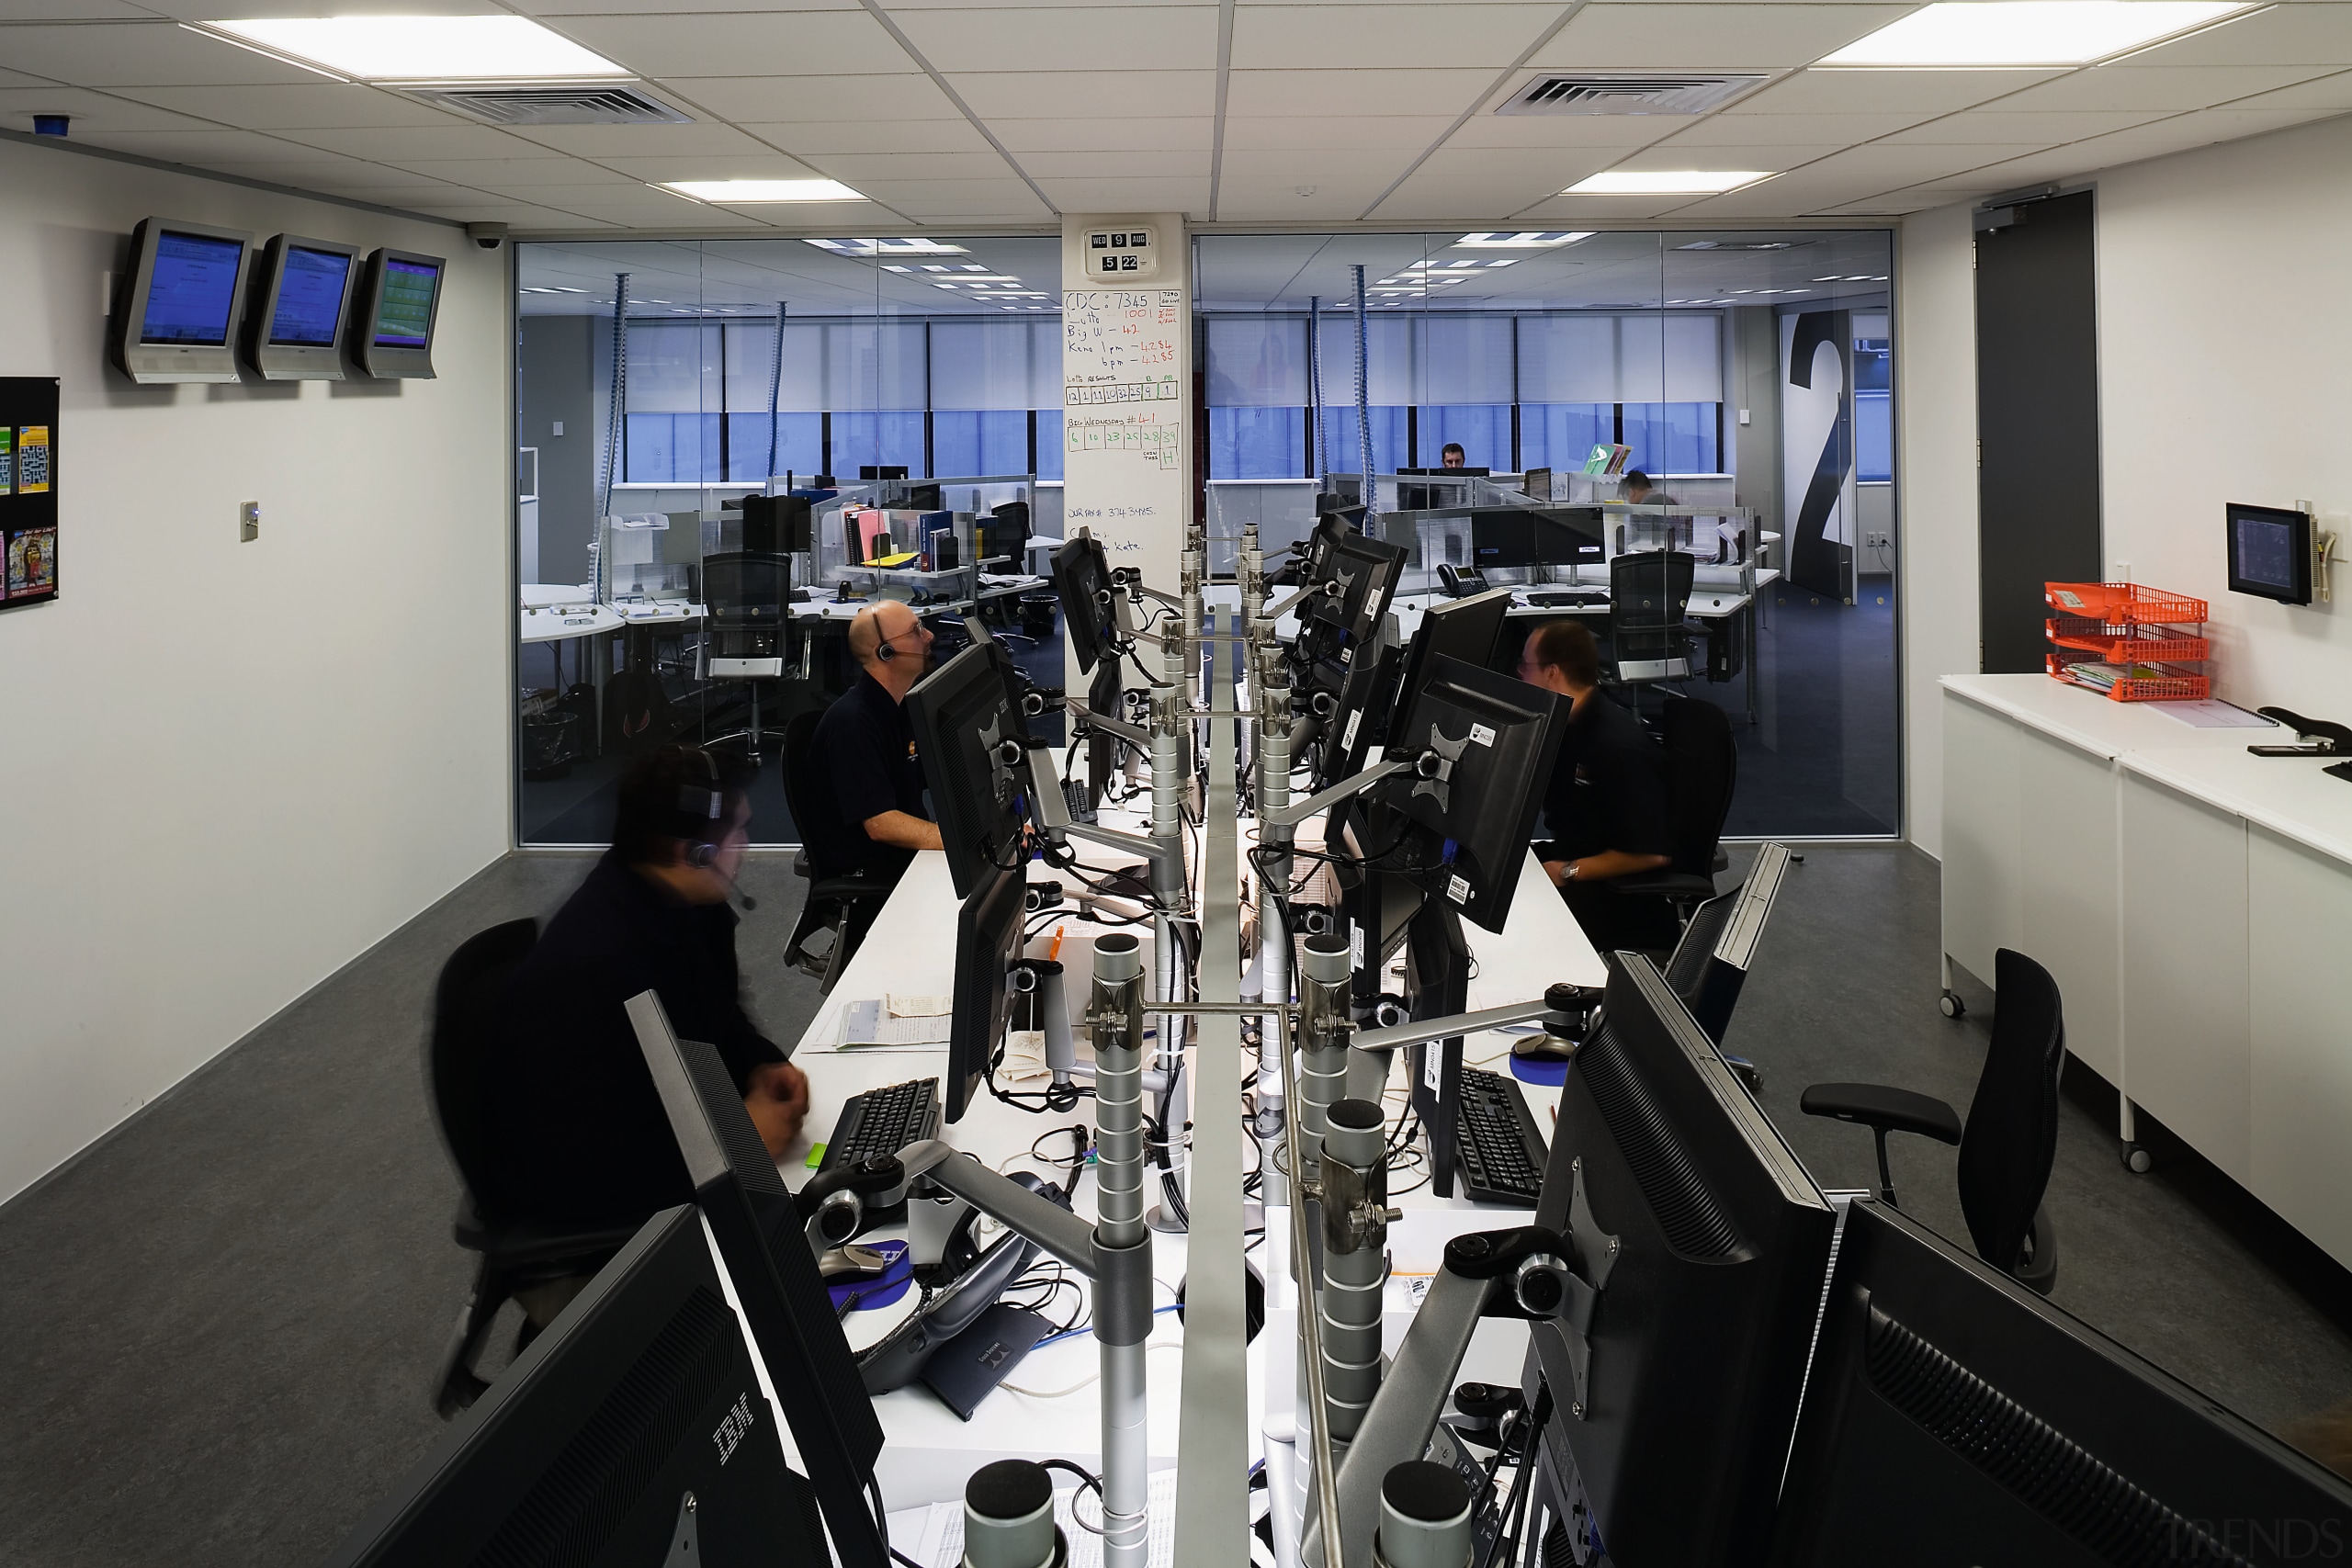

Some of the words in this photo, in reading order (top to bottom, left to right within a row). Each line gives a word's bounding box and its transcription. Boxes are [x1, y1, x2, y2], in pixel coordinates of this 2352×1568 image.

[1092, 236, 1106, 245] WED
[1114, 234, 1124, 245] 9
[1132, 235, 1146, 243] AUG
[1123, 257, 1137, 267] 22
[1065, 292, 1101, 310] CDC
[1113, 292, 1148, 309] 7345
[1067, 324, 1087, 342] Big
[1123, 323, 1140, 334] 42
[1068, 340, 1093, 353] Keno
[1140, 340, 1172, 353] 4284
[1102, 356, 1124, 370] 6pm
[1141, 349, 1175, 365] 4285
[1067, 375, 1084, 383] Lotto
[1093, 391, 1103, 400] 11
[1105, 389, 1116, 399] 10
[1117, 389, 1128, 399] 32
[1130, 388, 1141, 397] 25
[1145, 388, 1152, 398] 9
[1165, 385, 1170, 396] 1
[1069, 392, 1079, 401] 12
[1083, 392, 1089, 400] 1
[1084, 416, 1125, 425] WEDNESDAY
[1138, 412, 1155, 423] 41
[1163, 451, 1173, 465] H
[712, 1392, 754, 1466] IBM
